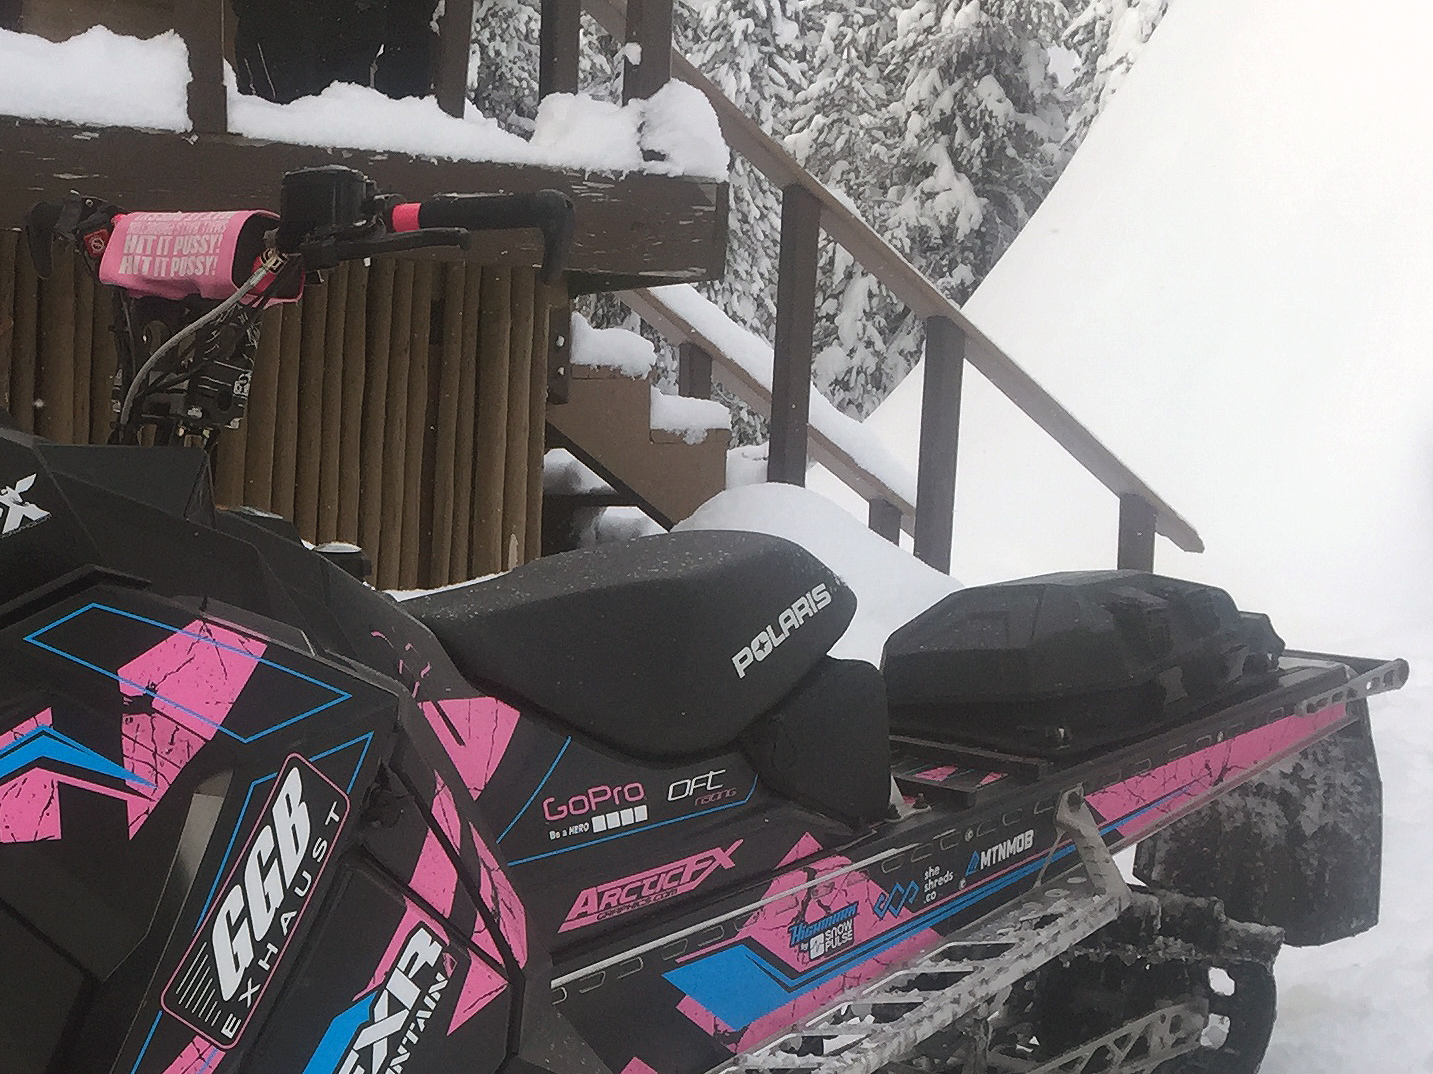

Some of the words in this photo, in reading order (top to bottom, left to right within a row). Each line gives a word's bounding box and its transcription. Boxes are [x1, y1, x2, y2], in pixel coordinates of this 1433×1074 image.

[124, 234, 156, 255] HIT
[156, 234, 173, 255] IT
[173, 233, 223, 255] PUSSY!
[118, 255, 153, 275] HIT
[153, 257, 169, 277] IT
[170, 255, 218, 277] PUSSY!
[732, 583, 832, 679] POLARIS
[542, 782, 645, 822] GoPro
[569, 822, 589, 836] HERO
[980, 829, 1035, 870] MTNMOB
[924, 870, 954, 892] shreds
[925, 864, 940, 879] she
[212, 767, 310, 1001] GGB
[221, 801, 340, 1039] EXHAUST
[825, 918, 853, 937] SNOW
[825, 930, 853, 952] PULSE
